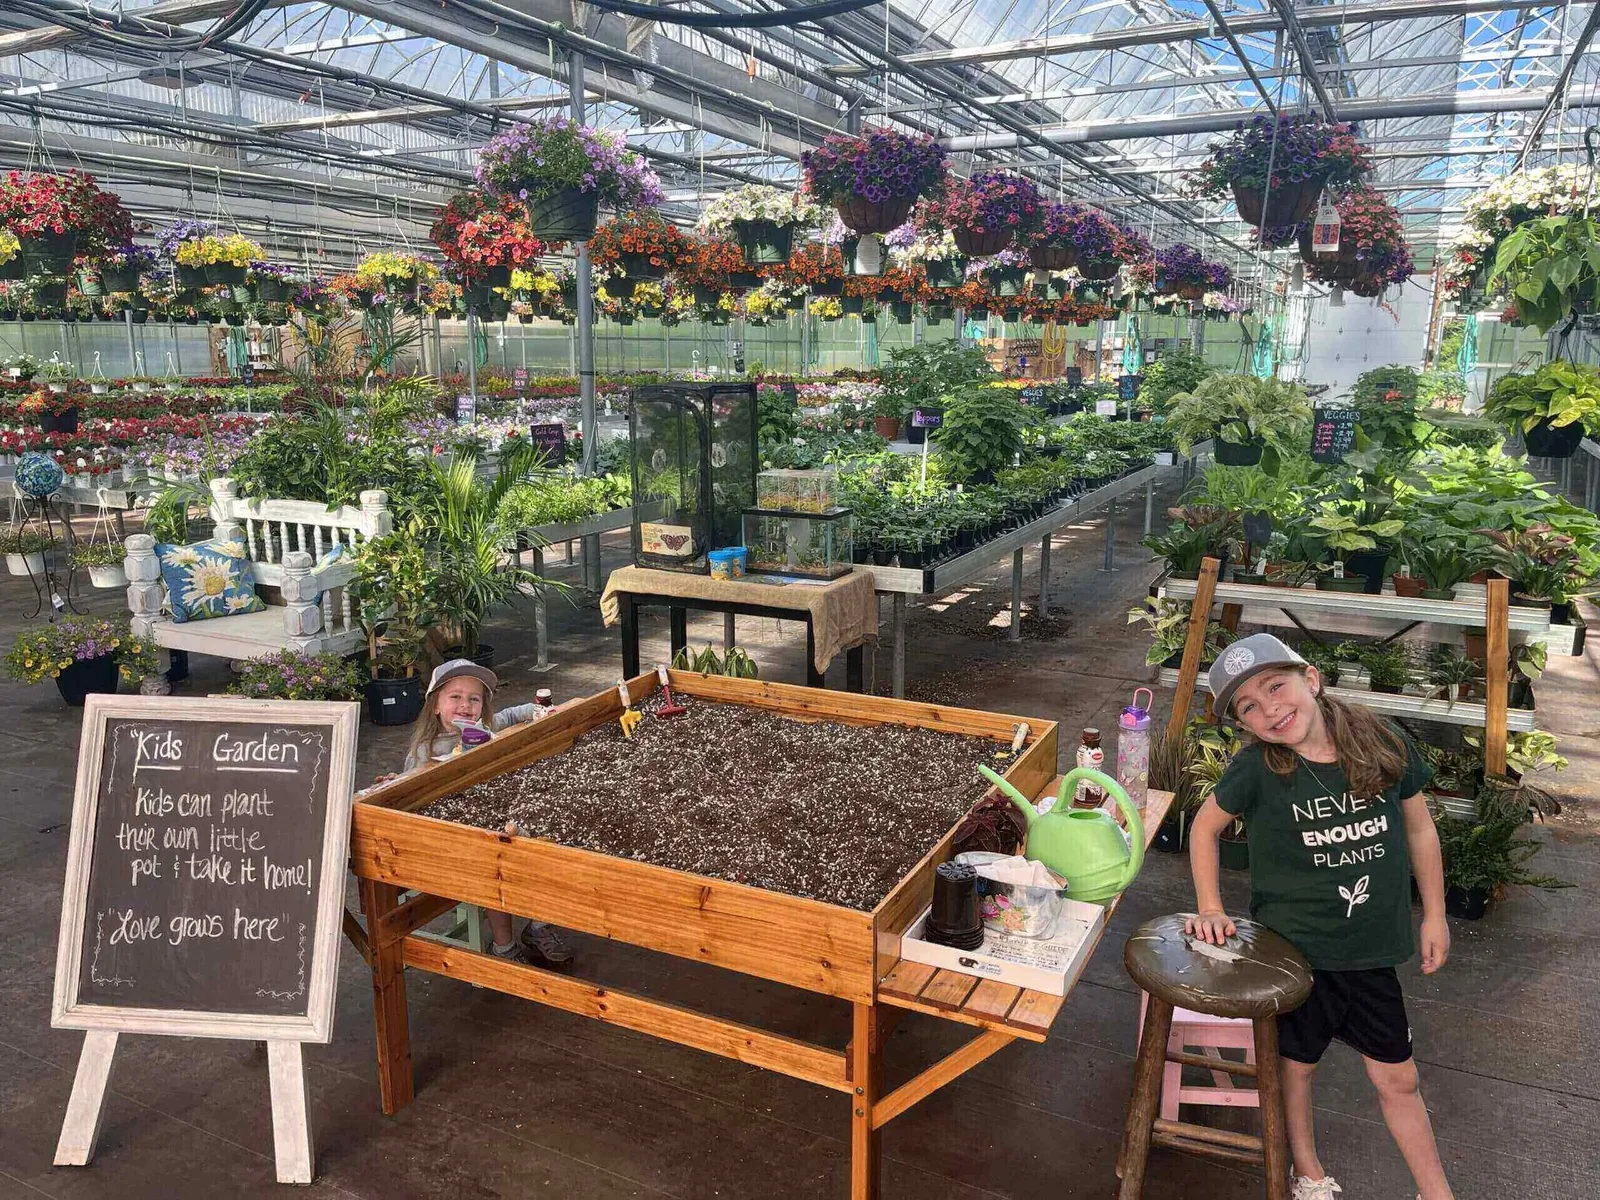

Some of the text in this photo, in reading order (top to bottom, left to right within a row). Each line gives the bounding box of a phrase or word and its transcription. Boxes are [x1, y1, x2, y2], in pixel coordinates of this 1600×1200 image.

[916, 410, 940, 424] Peppers
[1323, 410, 1360, 421] VEGGIES
[135, 787, 274, 823] Kids can plant
[1292, 790, 1386, 822] NEVE
[115, 822, 265, 852] their own little
[1302, 815, 1388, 847] ENOUGH
[1313, 843, 1386, 867] PLANTS
[131, 854, 162, 887] pot
[185, 853, 236, 886] take
[240, 858, 257, 885] it
[264, 856, 312, 895] home!
[168, 915, 225, 945] grows
